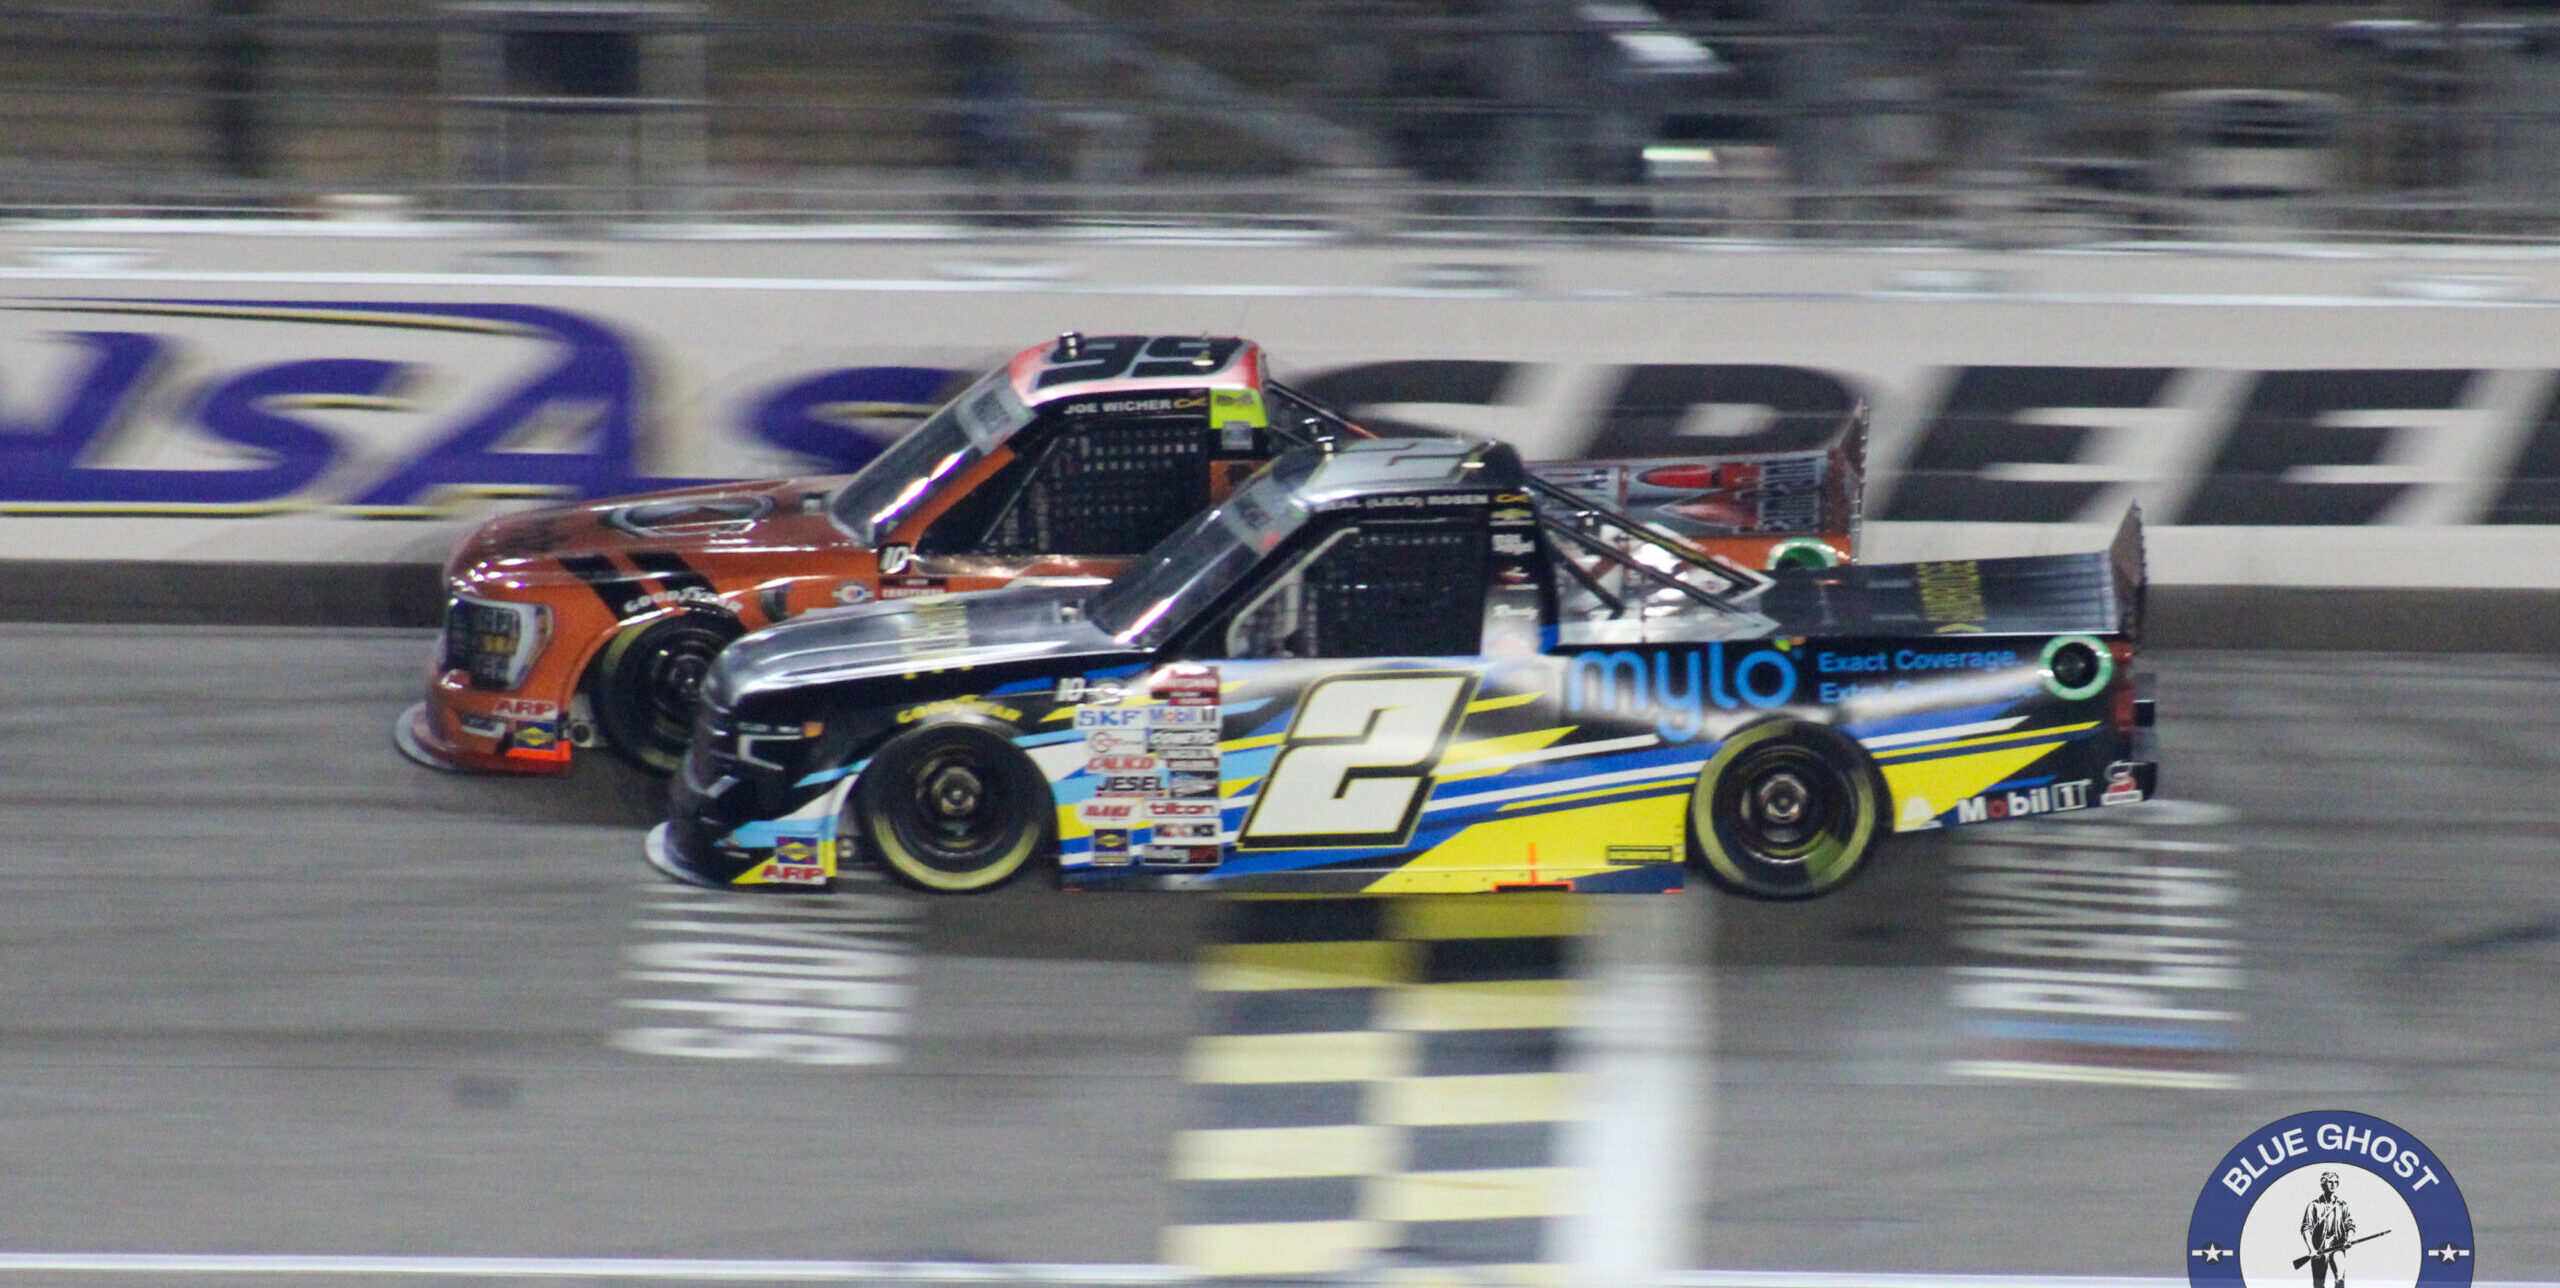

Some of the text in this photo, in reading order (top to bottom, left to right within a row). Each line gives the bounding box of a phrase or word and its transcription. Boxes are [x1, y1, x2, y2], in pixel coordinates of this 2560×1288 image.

[1063, 400, 1173, 415] JOE WICHER
[1818, 652, 1888, 672] Exact
[1568, 640, 1797, 742] mylo
[495, 701, 554, 715] ARP
[1150, 708, 1195, 723] Mobil
[1078, 710, 1142, 727] SKF
[1240, 670, 1478, 845] 2
[1095, 776, 1165, 791] JESEL
[1957, 787, 2050, 824] Mobil
[761, 865, 826, 880] ARP
